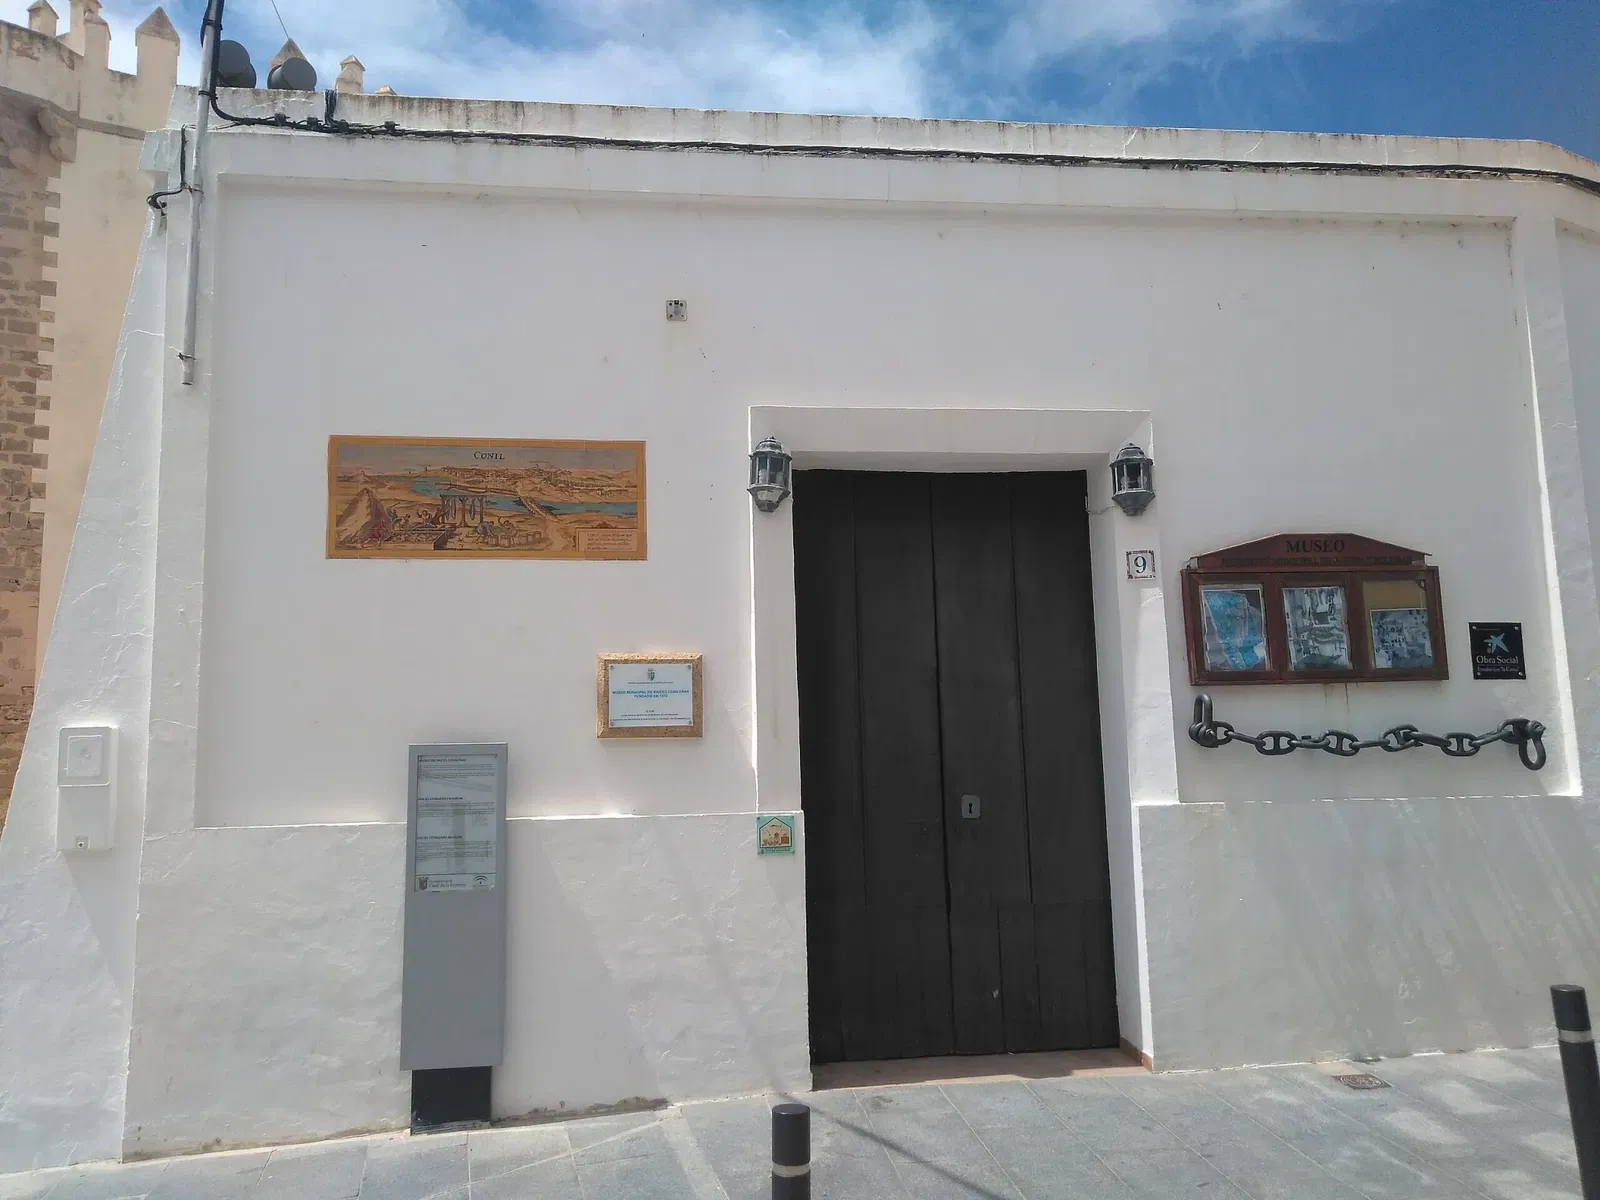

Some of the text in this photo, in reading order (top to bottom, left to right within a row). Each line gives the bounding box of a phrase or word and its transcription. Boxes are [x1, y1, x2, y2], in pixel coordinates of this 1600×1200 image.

[474, 451, 505, 460] CONIL
[1286, 539, 1345, 553] MUSEO
[1134, 556, 1147, 573] 9
[1476, 655, 1518, 664] Obra Social
